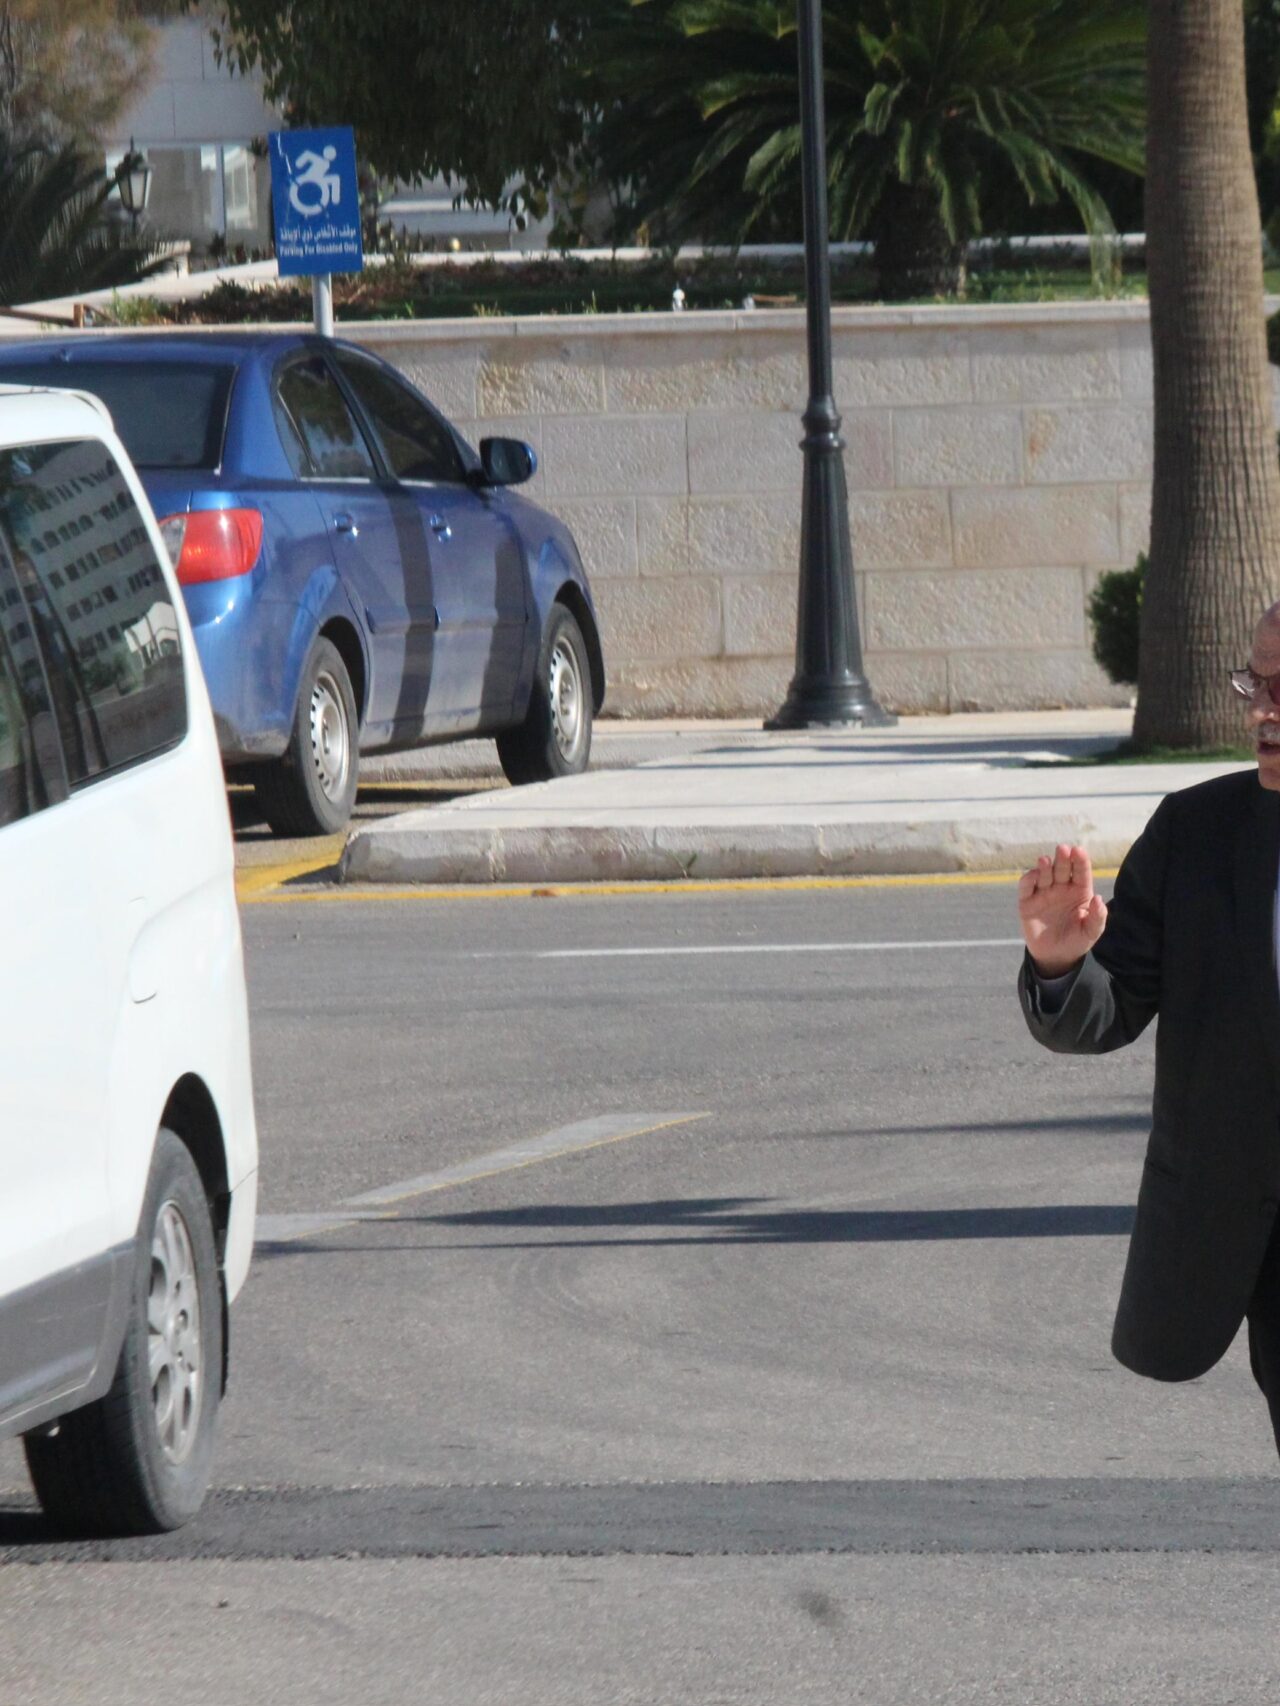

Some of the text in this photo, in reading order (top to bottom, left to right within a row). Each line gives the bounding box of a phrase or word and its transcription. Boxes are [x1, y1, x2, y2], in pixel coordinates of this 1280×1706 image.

[279, 241, 358, 257] Parking For Disabled Only
